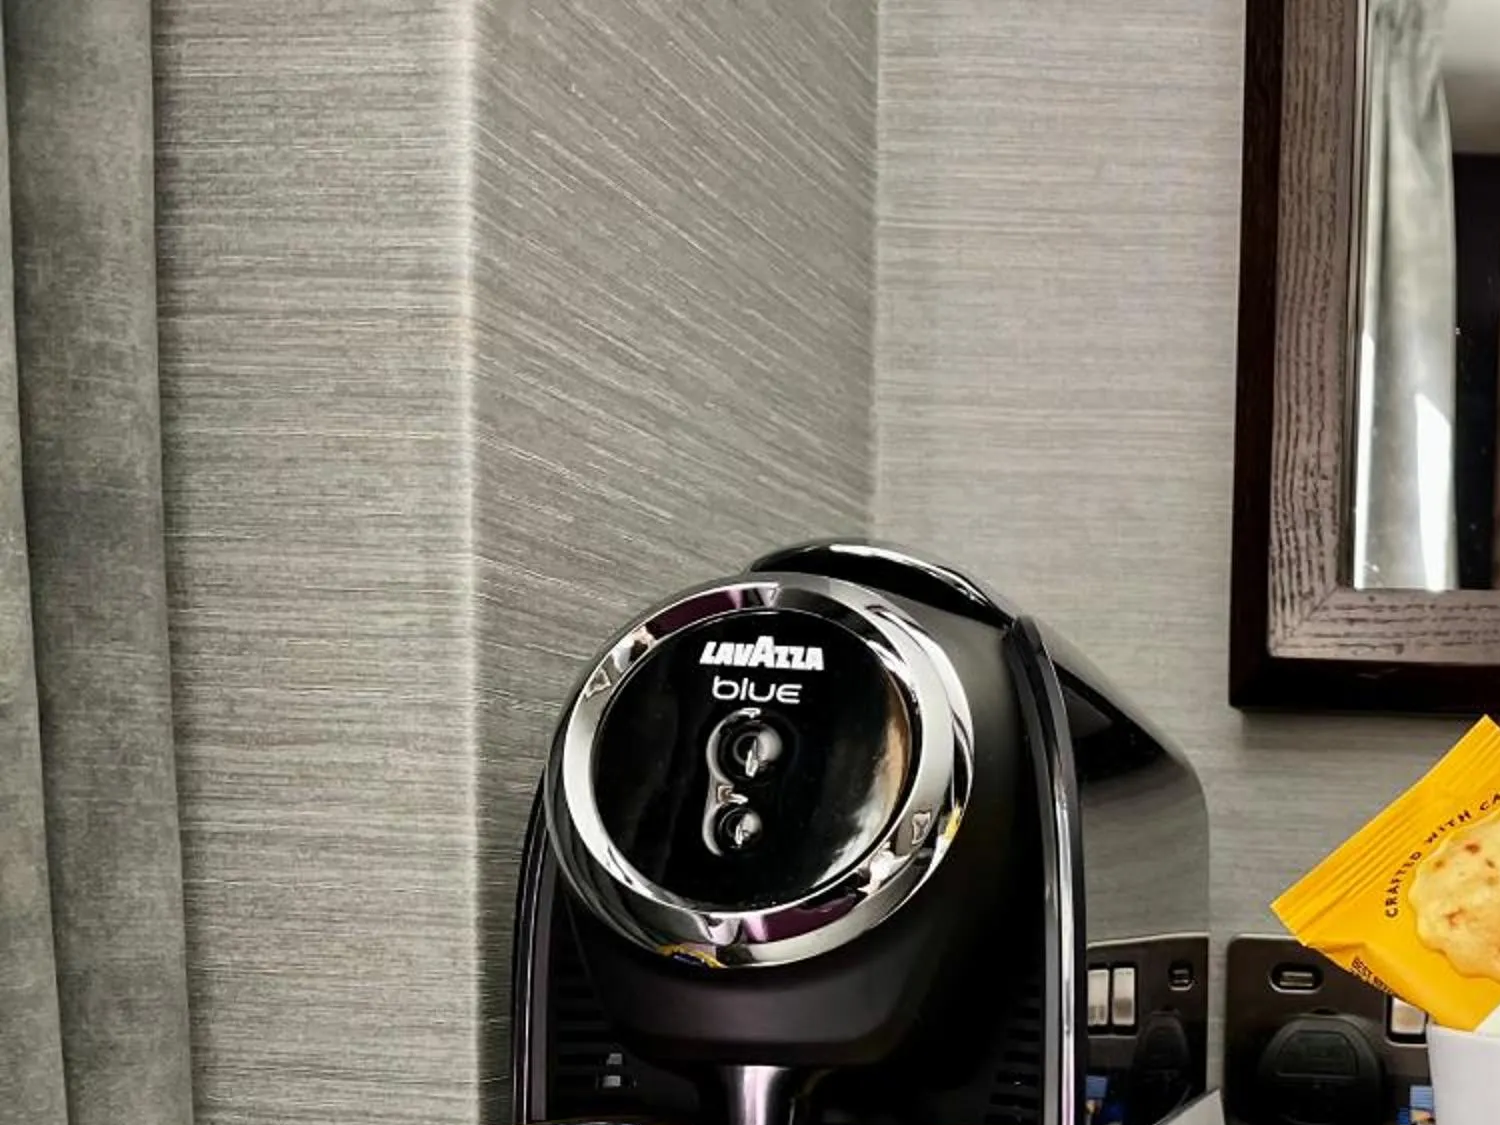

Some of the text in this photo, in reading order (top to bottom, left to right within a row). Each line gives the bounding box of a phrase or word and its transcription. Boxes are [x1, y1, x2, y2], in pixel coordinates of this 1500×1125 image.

[700, 636, 825, 671] LAVAZZA
[712, 676, 803, 704] blue
[1385, 852, 1422, 918] CRAFTED
[1424, 810, 1472, 843] WITH
